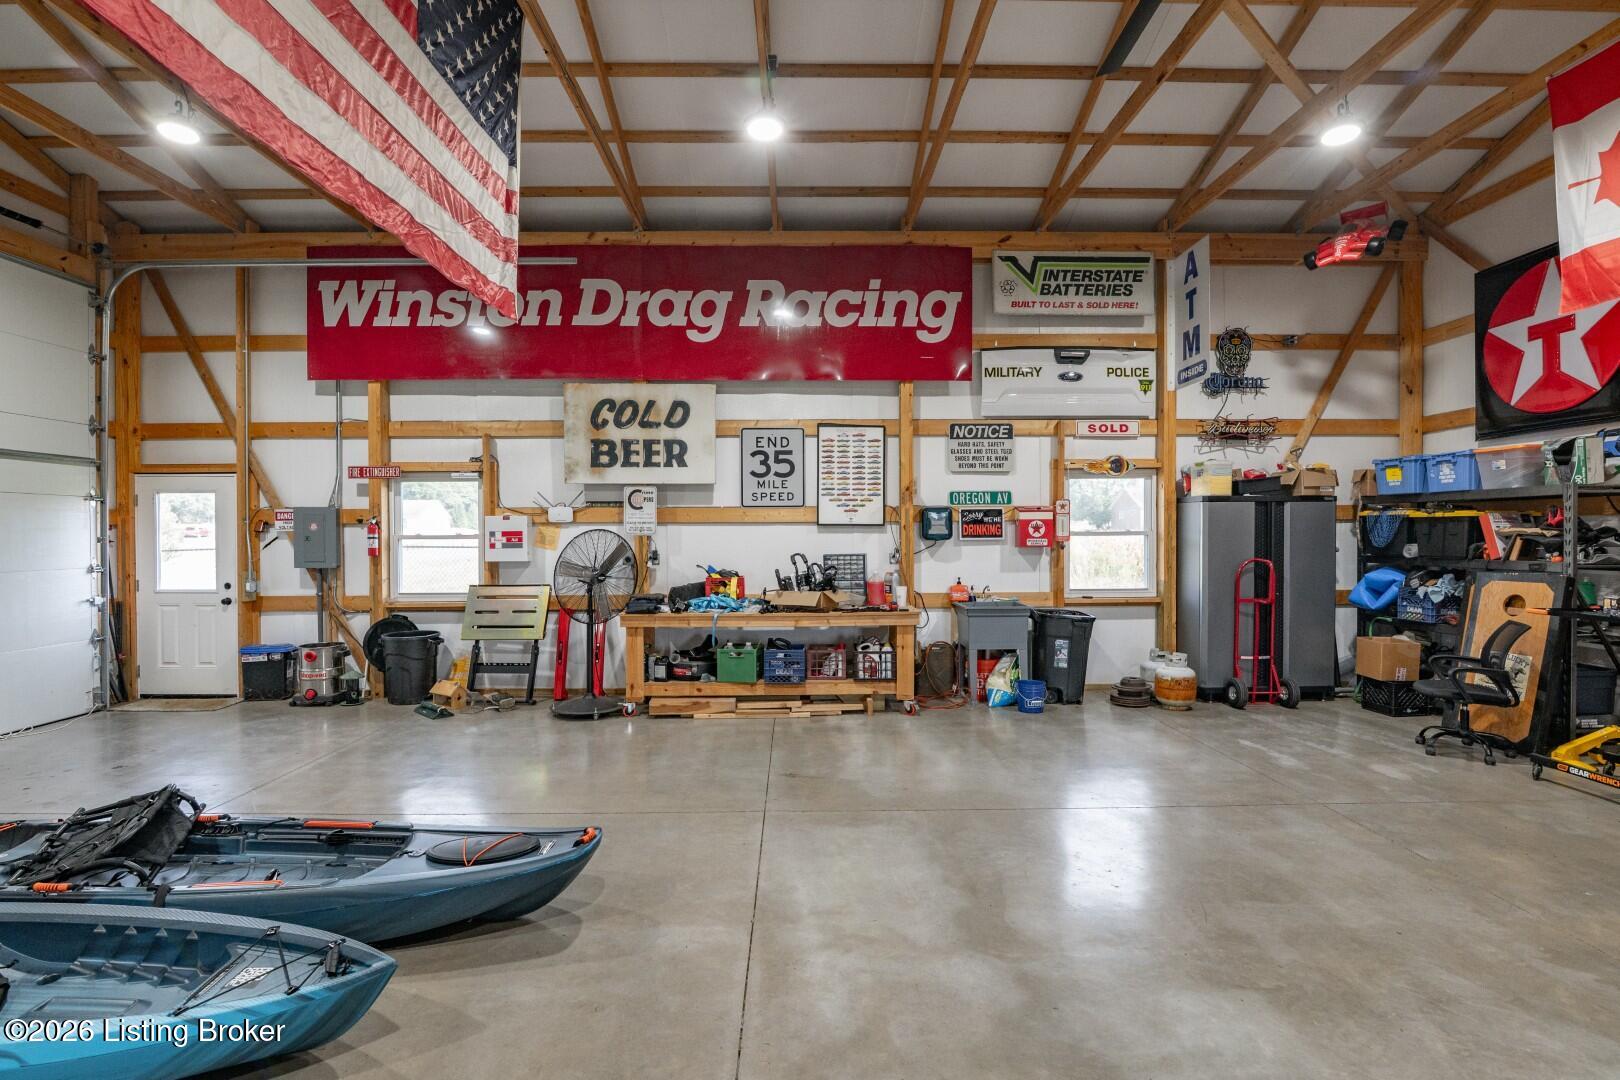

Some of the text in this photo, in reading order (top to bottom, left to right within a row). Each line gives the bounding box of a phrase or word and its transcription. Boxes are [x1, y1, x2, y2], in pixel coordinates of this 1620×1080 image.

[1043, 269, 1144, 283] INTERSTATE
[1040, 283, 1133, 297] BATTERIES
[571, 277, 733, 344] Drag
[739, 277, 963, 344] Racing
[1011, 300, 1036, 308] BUILT
[1039, 300, 1051, 308] TO
[1086, 301, 1109, 309] SOLD
[1111, 301, 1139, 309] HERE!
[984, 366, 1043, 378] MILITARY
[1106, 367, 1150, 378] POLICE
[1180, 363, 1204, 381] INSIDE
[590, 398, 691, 431] COLD
[953, 425, 1010, 438] NOTICE
[1088, 423, 1129, 433] SOLD
[755, 436, 790, 449] END
[590, 438, 689, 469] BEER
[749, 449, 796, 479] 35
[349, 467, 400, 478] FIRE EXTINGUISHER
[756, 479, 788, 489] MILE
[751, 491, 794, 502] SPEED
[952, 492, 1009, 504] OREGON AV
[962, 511, 984, 522] Sorry
[962, 523, 1001, 536] DRINKING
